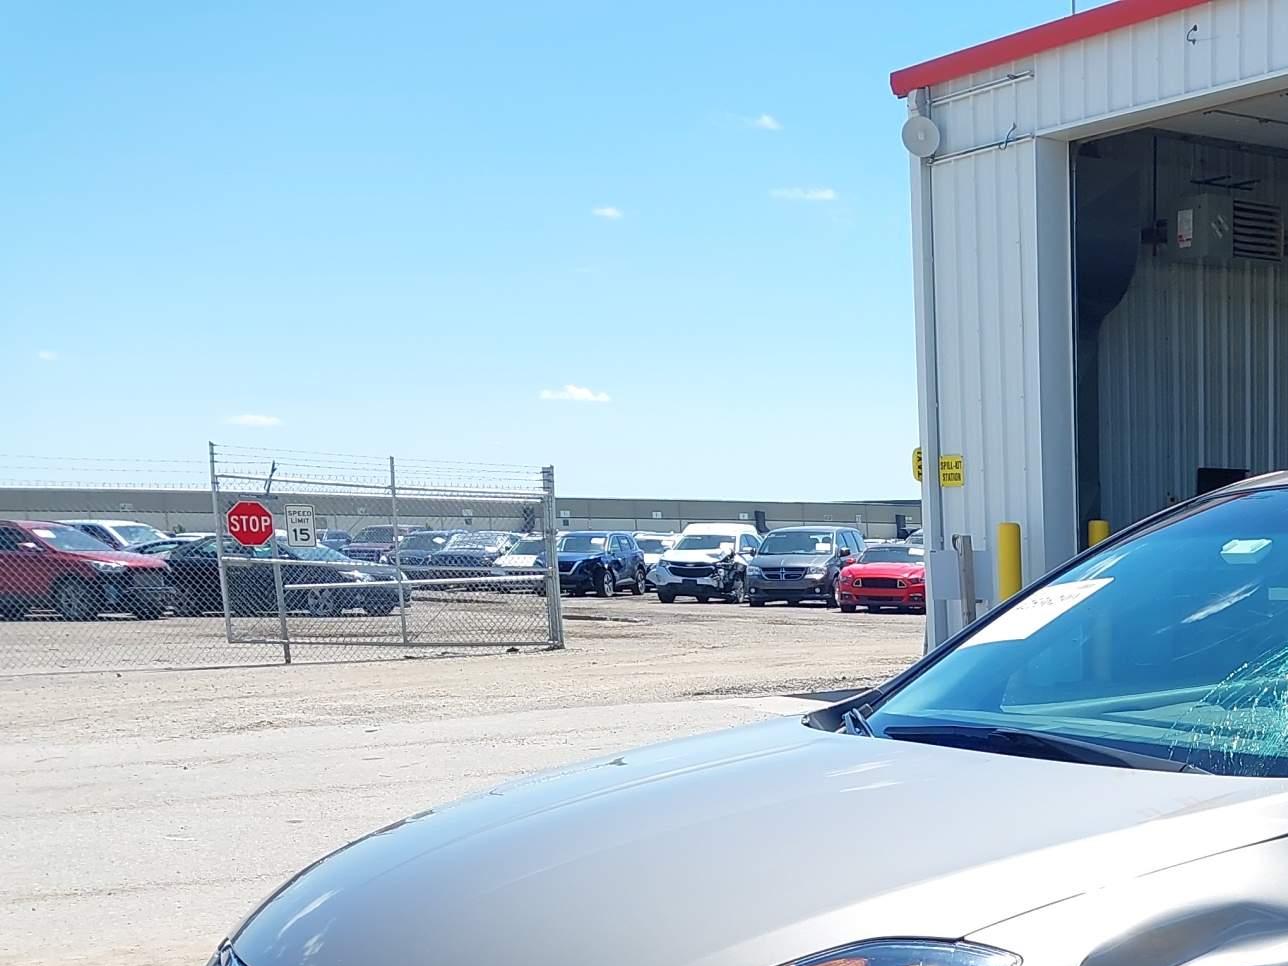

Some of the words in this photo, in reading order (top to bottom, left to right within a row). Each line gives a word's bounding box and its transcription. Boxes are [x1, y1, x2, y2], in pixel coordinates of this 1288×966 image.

[942, 472, 962, 481] STATION
[230, 515, 271, 532] STOP
[292, 528, 311, 542] 15
